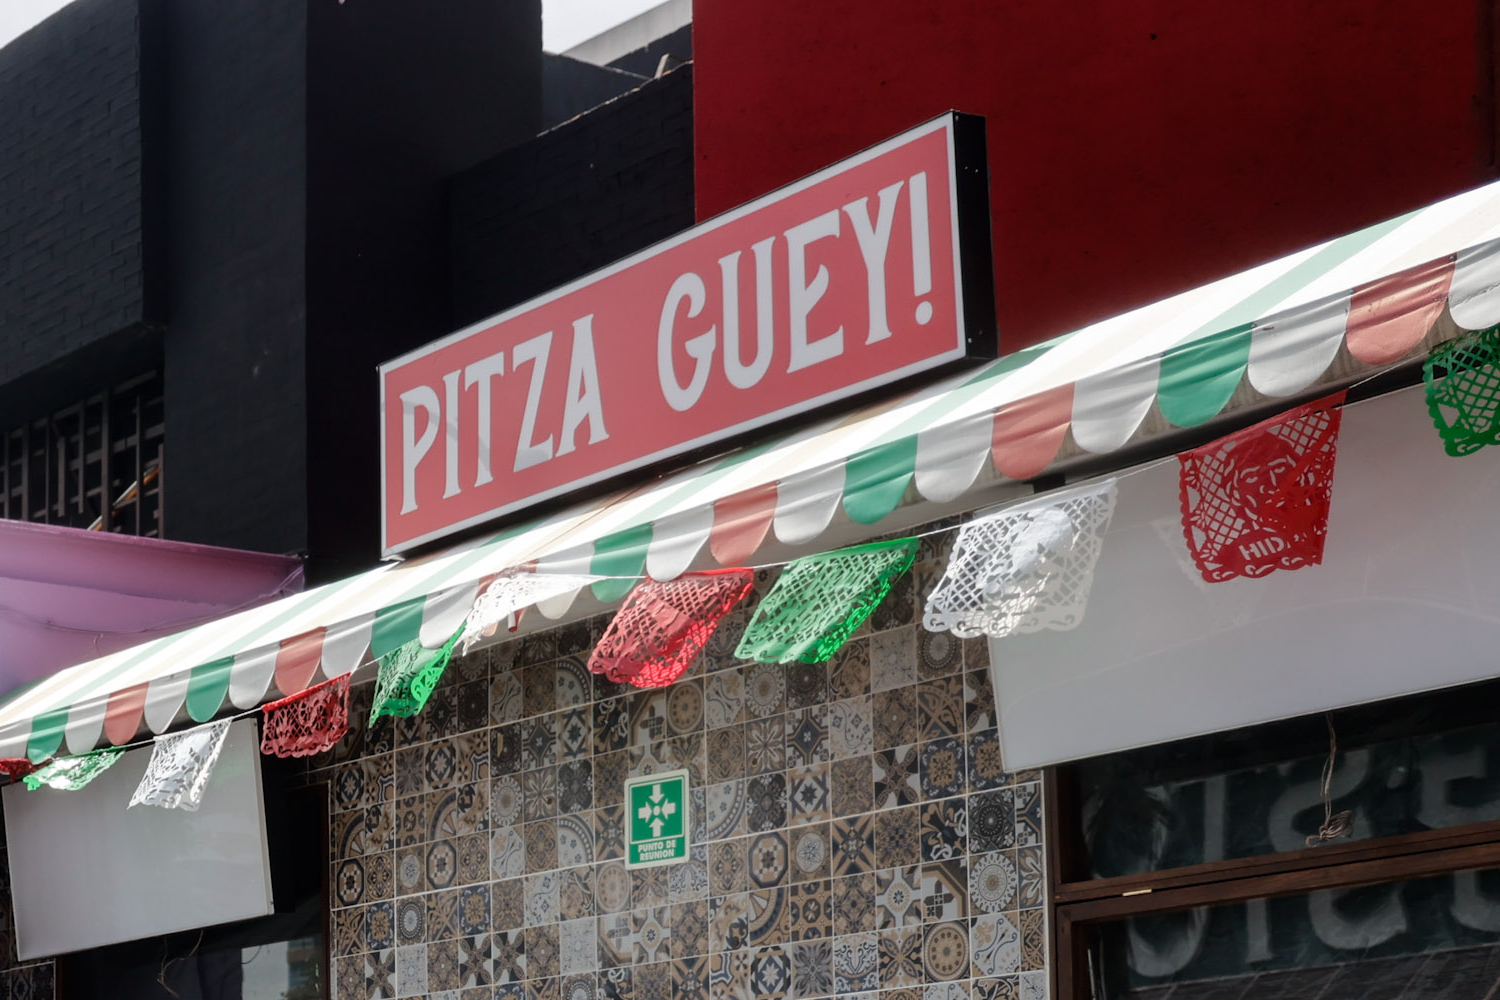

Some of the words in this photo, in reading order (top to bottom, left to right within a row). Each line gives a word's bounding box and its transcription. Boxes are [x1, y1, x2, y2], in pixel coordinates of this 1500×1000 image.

[399, 313, 609, 517] PITZA
[656, 171, 932, 412] GUEY!
[638, 841, 664, 852] PUNTO
[666, 840, 676, 848] DE
[640, 849, 674, 861] REUNION
